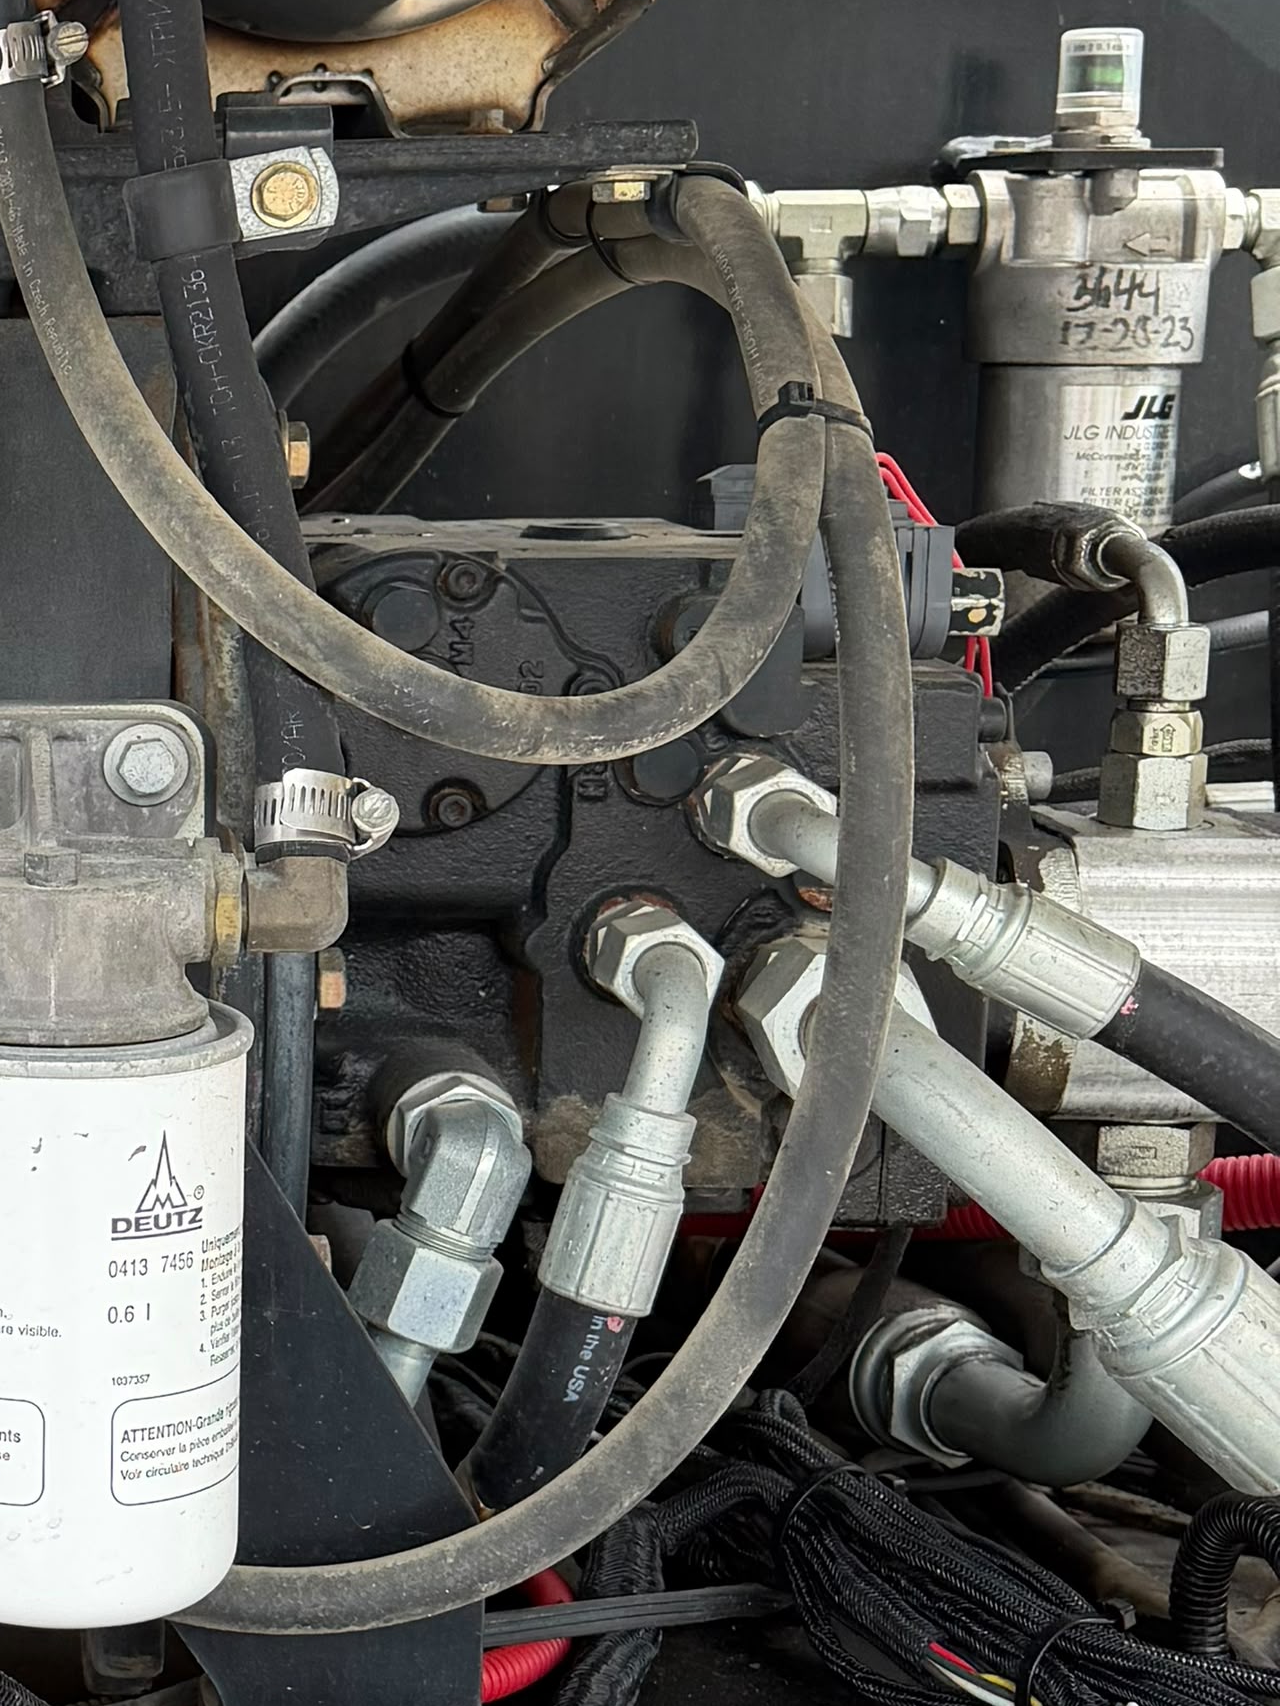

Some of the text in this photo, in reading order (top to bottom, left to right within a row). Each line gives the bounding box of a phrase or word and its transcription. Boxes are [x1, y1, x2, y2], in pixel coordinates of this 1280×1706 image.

[1121, 394, 1176, 420] JLG
[1064, 425, 1100, 440] JLG
[111, 1206, 203, 1234] DEUTZ
[108, 1251, 193, 1278] 0413 7456
[108, 1305, 135, 1324] 0.6
[18, 1325, 62, 1337] visible.
[579, 1334, 600, 1361] the
[563, 1365, 590, 1403] USA
[120, 1468, 142, 1480] Voir
